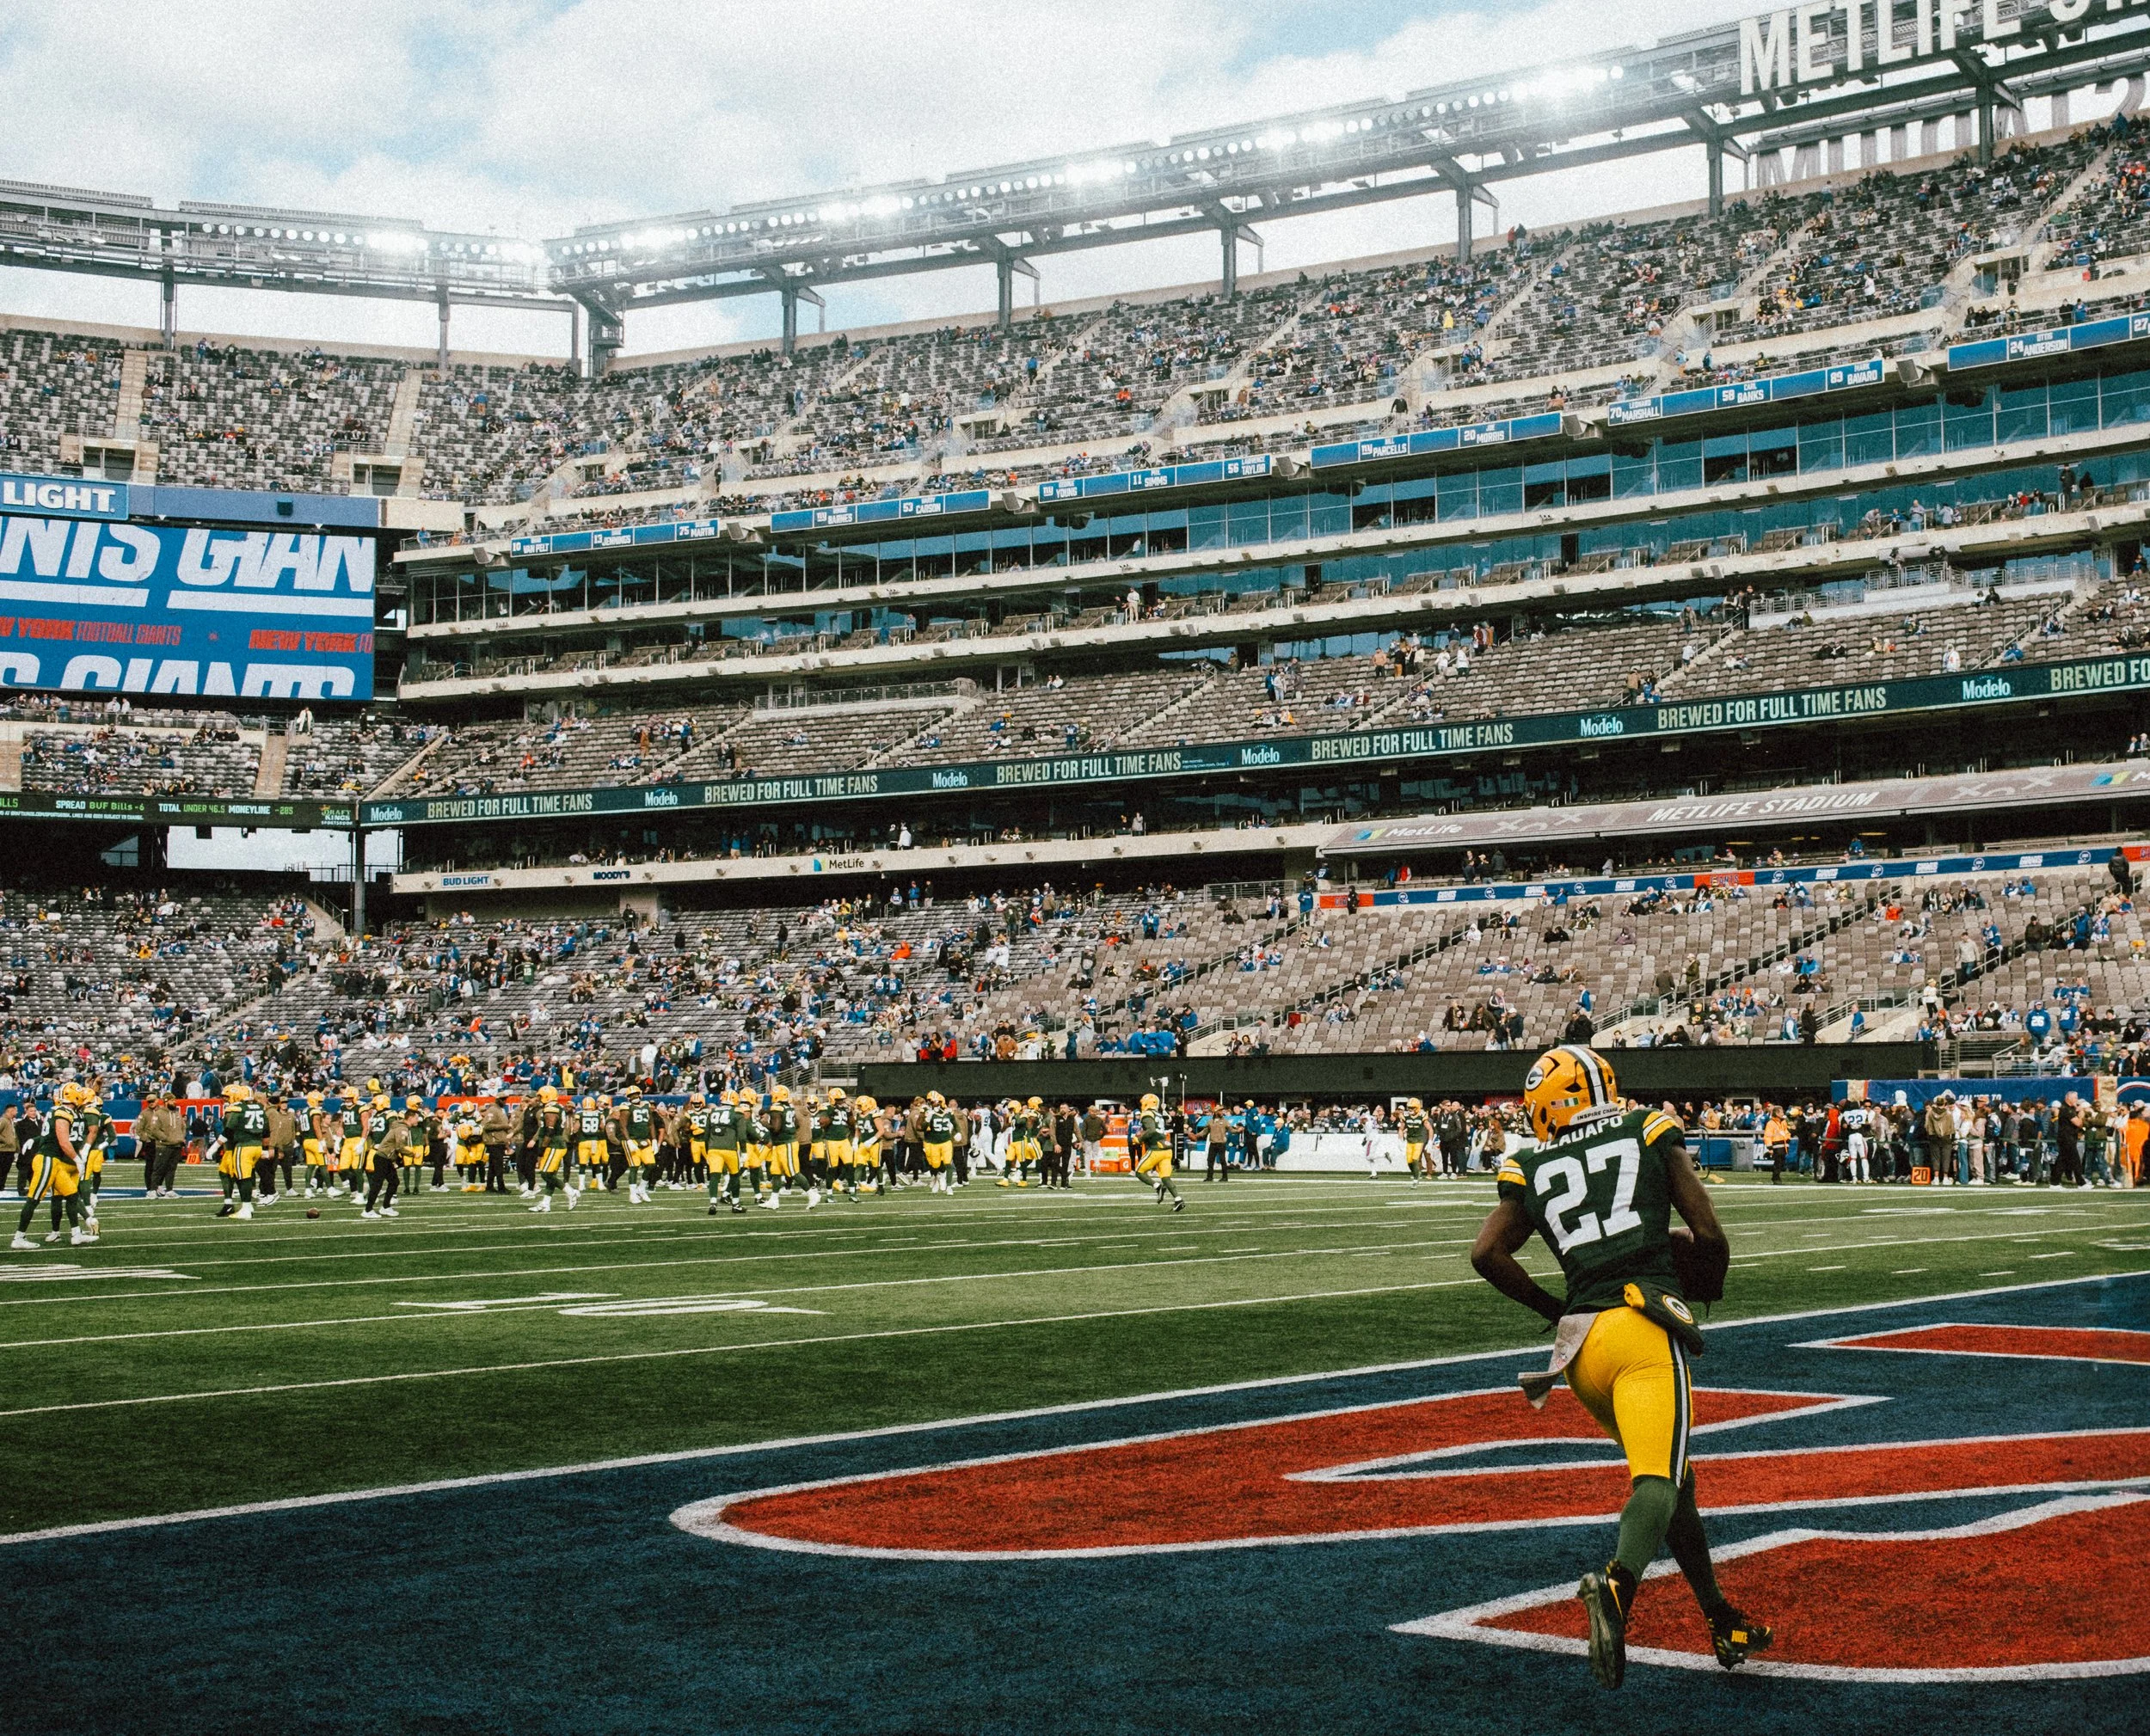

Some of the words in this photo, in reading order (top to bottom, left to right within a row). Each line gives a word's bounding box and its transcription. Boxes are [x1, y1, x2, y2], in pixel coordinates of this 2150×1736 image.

[2010, 340, 2024, 353] 24
[2024, 339, 2067, 357] ANDERSON
[1830, 371, 1844, 383] 89
[1737, 390, 1764, 403] BANKS
[1622, 407, 1660, 422] MARSHALL
[1464, 430, 1476, 441] 20
[1477, 431, 1504, 444] MORRIS
[1373, 443, 1407, 457] PARCELLS
[1242, 463, 1265, 475] TAYLOR
[1145, 475, 1167, 488] SIMMS
[1056, 487, 1078, 498] YOUNG
[915, 503, 941, 515] CARSON
[18, 617, 76, 641] YORK
[77, 621, 135, 645] FOOTBALL
[136, 623, 182, 646] GIANTS
[249, 629, 304, 651] NEW
[2050, 661, 2126, 690] BREWED
[1962, 678, 2011, 701] Modelo
[1657, 703, 1722, 729] BREWED
[1726, 700, 1756, 723] FOR
[1760, 696, 1798, 720] FULL
[1802, 692, 1840, 715] TIME
[1845, 687, 1887, 712] FANS
[1580, 716, 1624, 737] Modelo
[1312, 736, 1370, 760] BREWED
[1373, 733, 1400, 755] FOR
[1403, 731, 1436, 752] FULL
[1439, 727, 1473, 749] TIME
[1477, 723, 1514, 745] FANS
[1241, 745, 1281, 765] Modelo
[996, 763, 1051, 784] BREWED
[1054, 760, 1079, 780] FOR
[1081, 758, 1112, 777] FULL
[1115, 755, 1146, 775] TIME
[1148, 751, 1182, 772] FANS
[932, 771, 968, 788] Modelo
[704, 784, 755, 804] BREWED
[758, 782, 781, 801] FOR
[783, 781, 812, 799] FULL
[814, 778, 845, 796] TIME
[847, 775, 878, 794] FANS
[56, 800, 86, 810] SPREAD
[89, 801, 108, 810] BUF
[111, 801, 132, 811] Bills
[428, 800, 475, 819] BREWED
[477, 798, 500, 816] FOR
[502, 796, 530, 814] FULL
[532, 795, 561, 813] TIME
[562, 793, 593, 811] FANS
[645, 790, 679, 807] Modelo
[158, 803, 181, 813] TOTAL
[183, 804, 207, 813] UNDER
[228, 805, 272, 815] MONEYLINE
[371, 807, 402, 821] Modelo
[1646, 803, 1759, 823] METLIFE
[1760, 791, 1880, 814] STADIUM
[1385, 824, 1463, 838] MetLife
[828, 858, 864, 870] MetLife
[443, 877, 462, 886] BUD
[463, 875, 489, 886] LIGHT
[593, 870, 630, 880] MOODY'S
[1576, 1110, 1601, 1121] INSPIRE
[582, 1117, 599, 1133] 58
[1914, 1169, 1928, 1182] 20
[1533, 1138, 1643, 1255] 27
